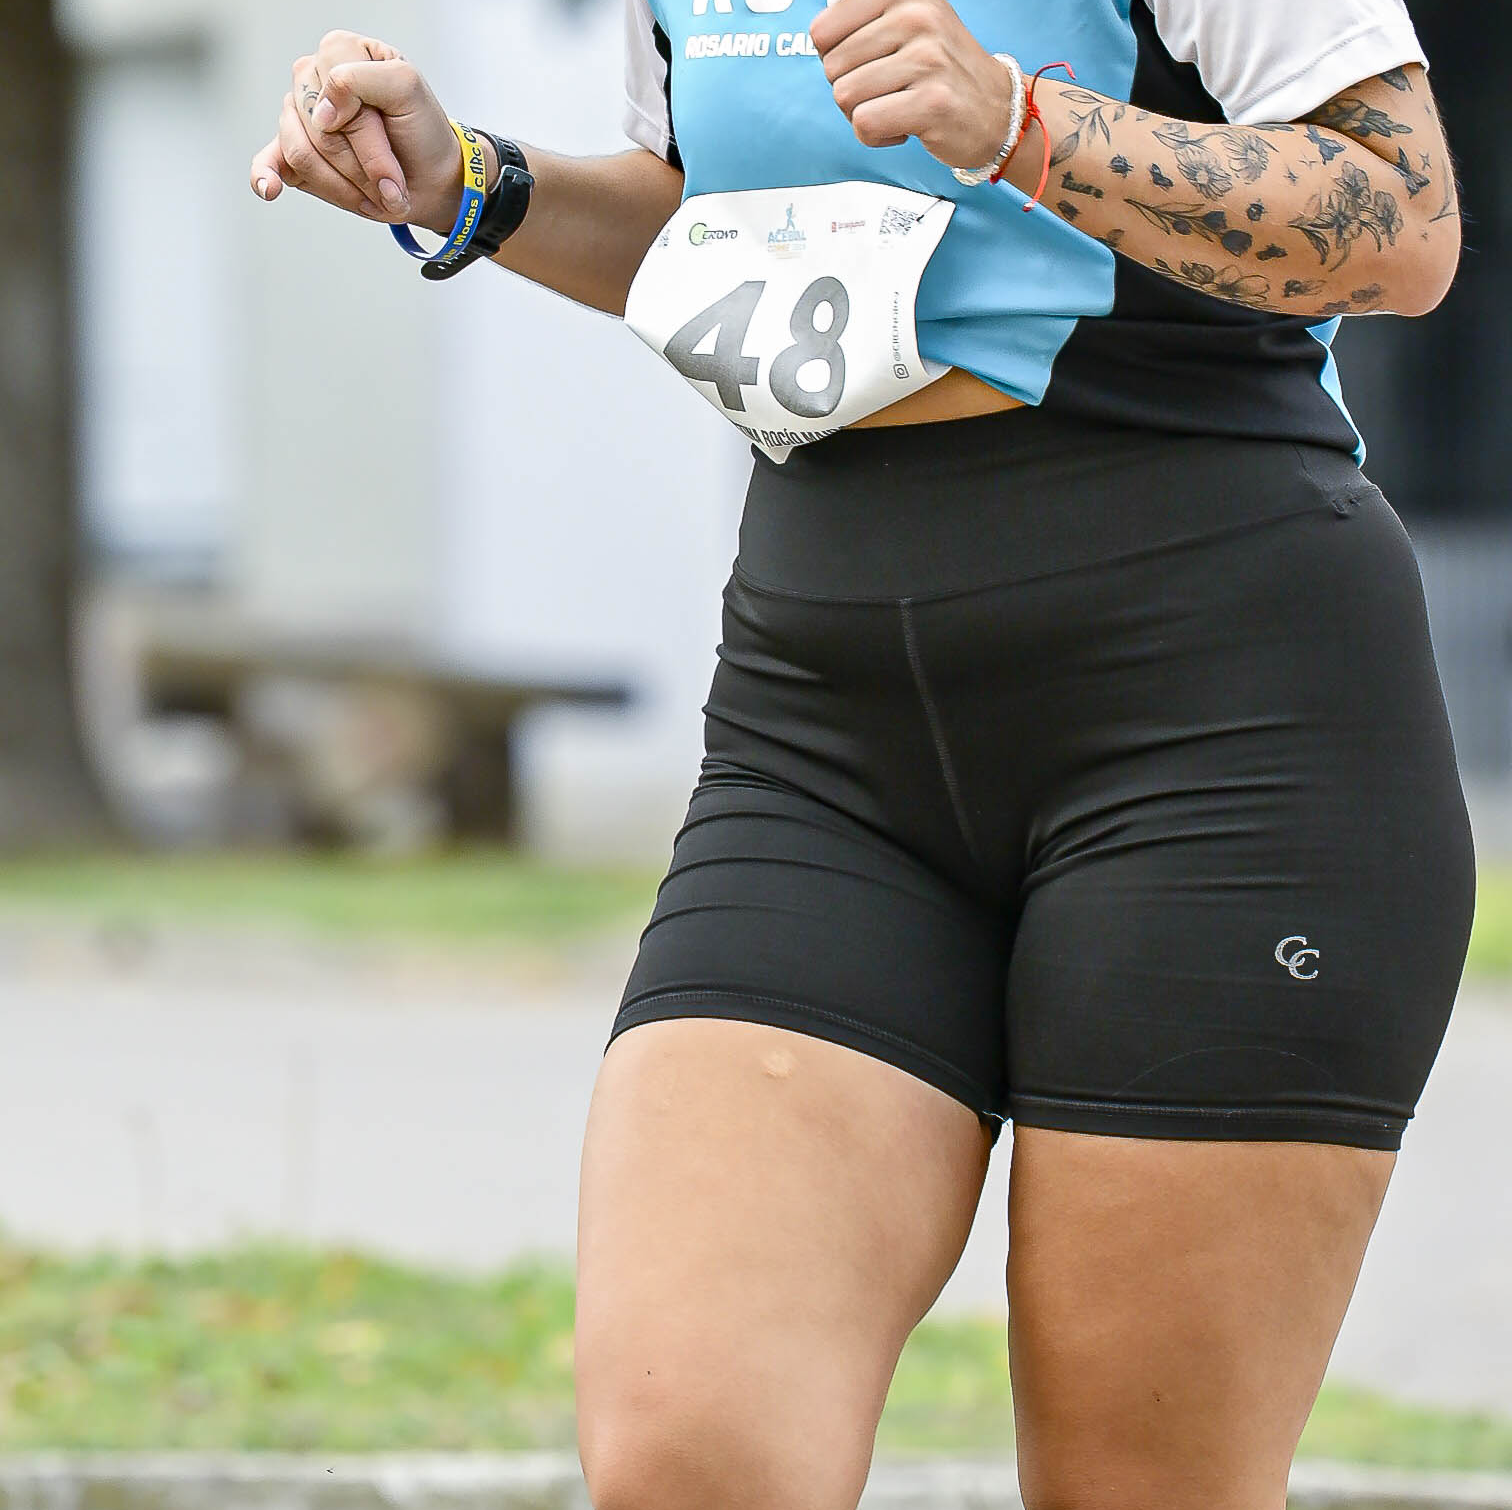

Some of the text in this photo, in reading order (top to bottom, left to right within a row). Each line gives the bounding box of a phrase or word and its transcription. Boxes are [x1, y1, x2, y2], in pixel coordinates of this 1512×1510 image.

[684, 32, 771, 60] ROSARIO
[453, 198, 479, 246] Modas
[663, 276, 850, 419] 48
